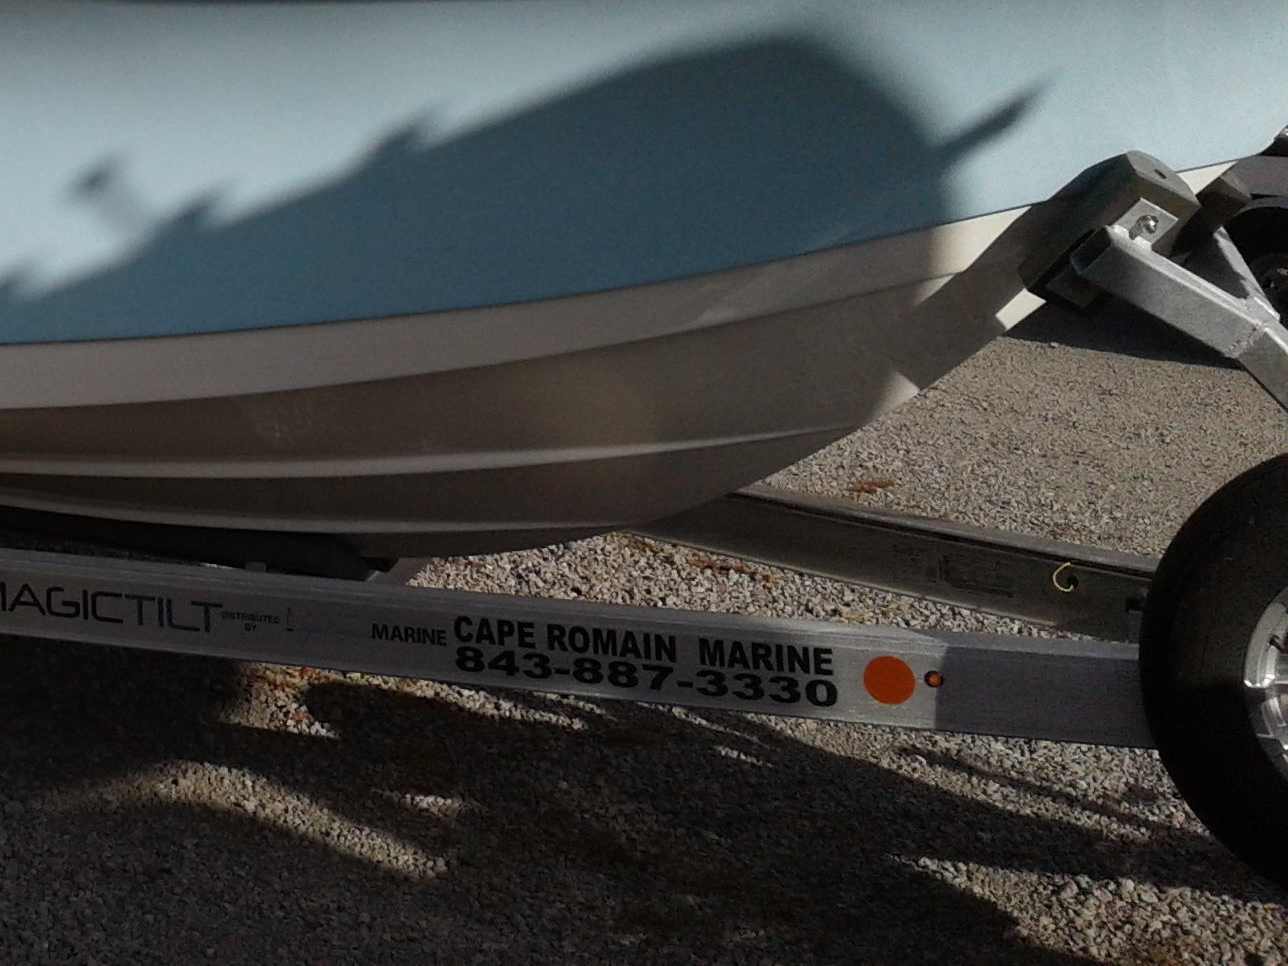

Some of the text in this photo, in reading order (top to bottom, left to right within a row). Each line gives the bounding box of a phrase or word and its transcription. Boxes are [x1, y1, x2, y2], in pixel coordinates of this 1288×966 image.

[371, 623, 448, 647] MARINE
[453, 615, 834, 676] CAPE ROMAIN MARINE
[455, 646, 838, 707] 843-887-3330
